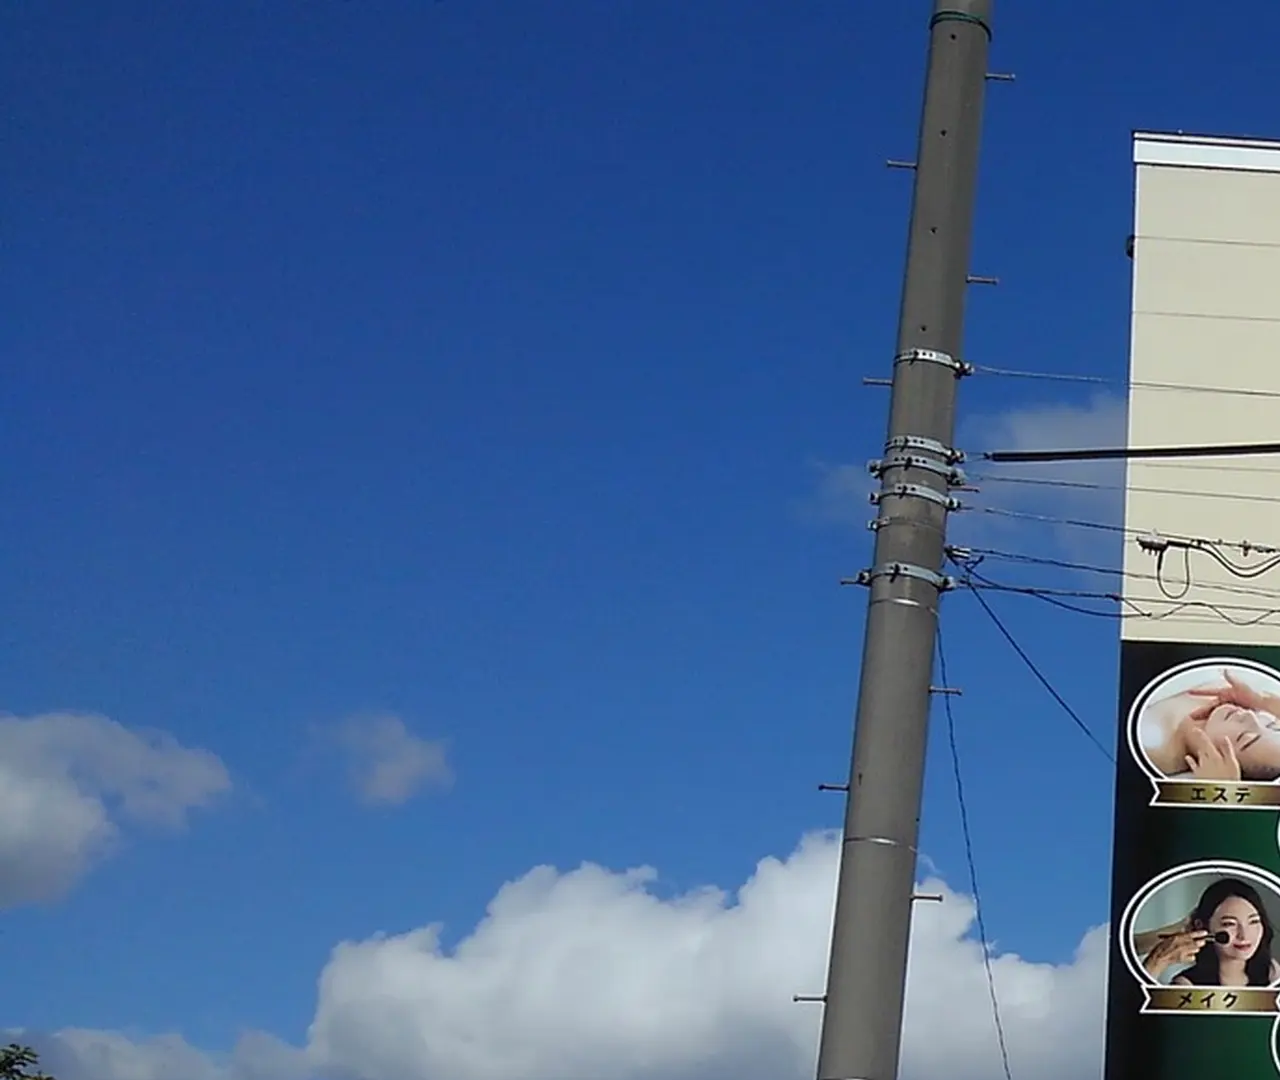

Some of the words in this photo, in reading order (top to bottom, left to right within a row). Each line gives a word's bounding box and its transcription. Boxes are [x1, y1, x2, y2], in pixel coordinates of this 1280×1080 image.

[1190, 786, 1251, 803] エステ
[1176, 992, 1239, 1009] メイク
